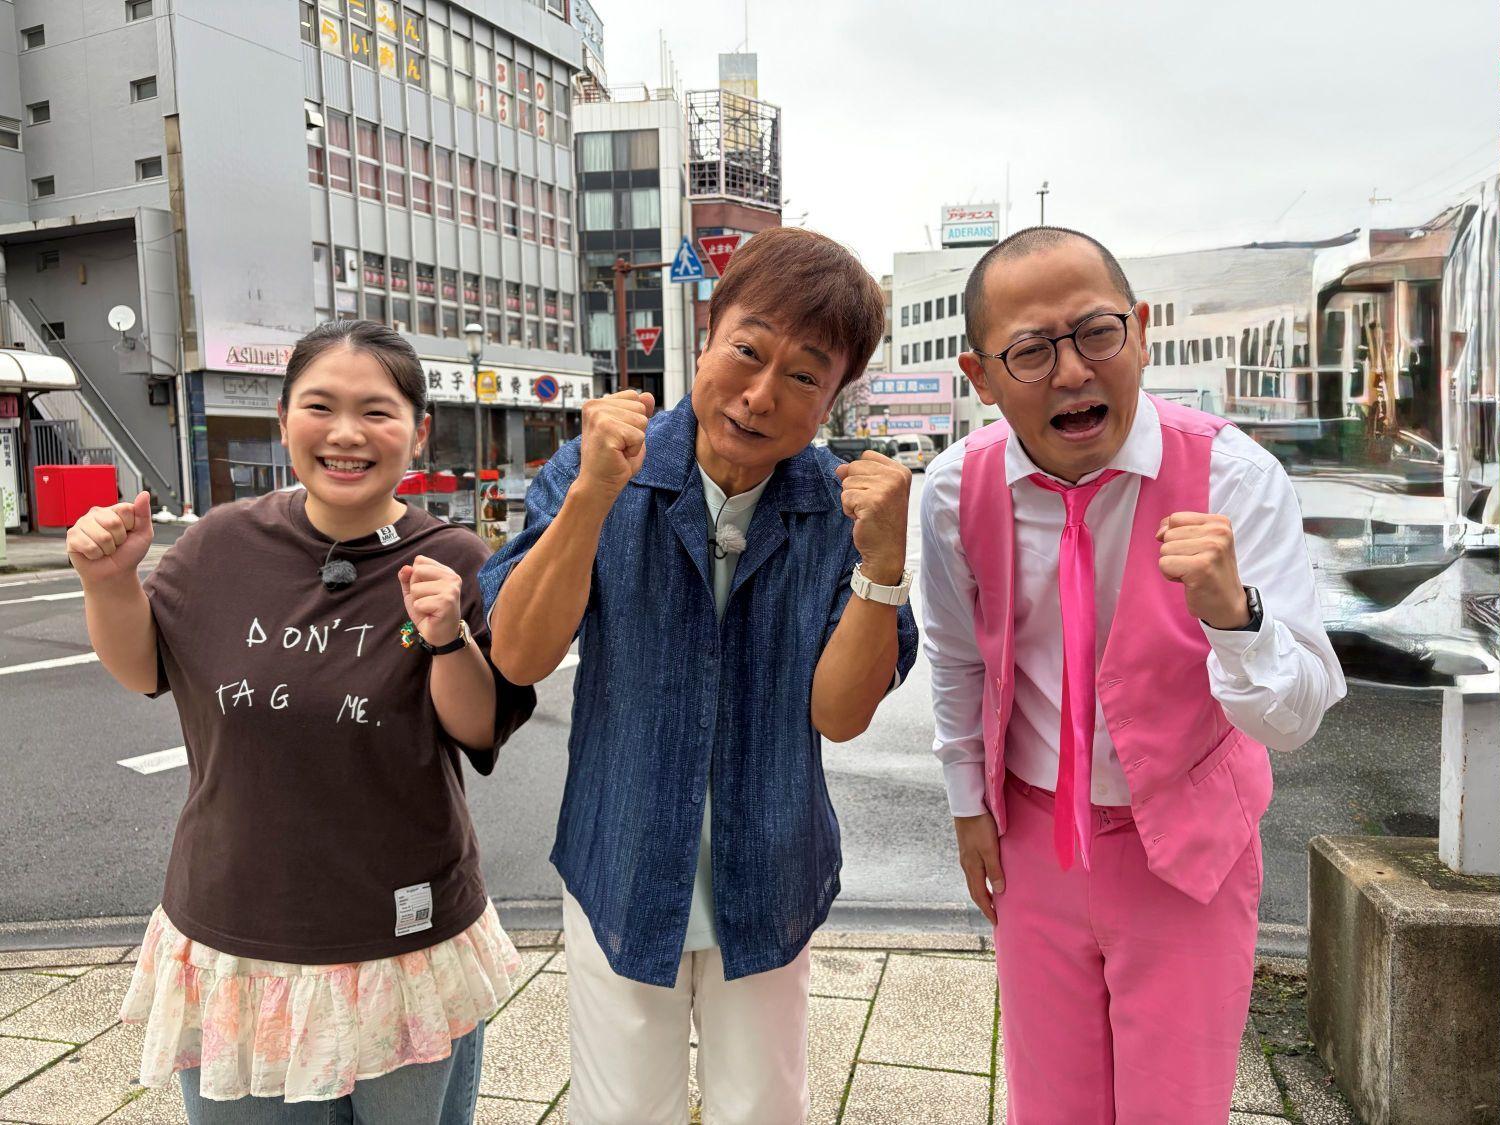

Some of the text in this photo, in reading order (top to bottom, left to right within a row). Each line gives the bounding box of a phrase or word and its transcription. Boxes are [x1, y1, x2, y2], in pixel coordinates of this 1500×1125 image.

[948, 226, 993, 239] ADERANS
[708, 244, 733, 255] 止まれ
[428, 369, 464, 391] 餃子
[246, 617, 374, 657] DON'T
[215, 679, 381, 726] TAG ME.
